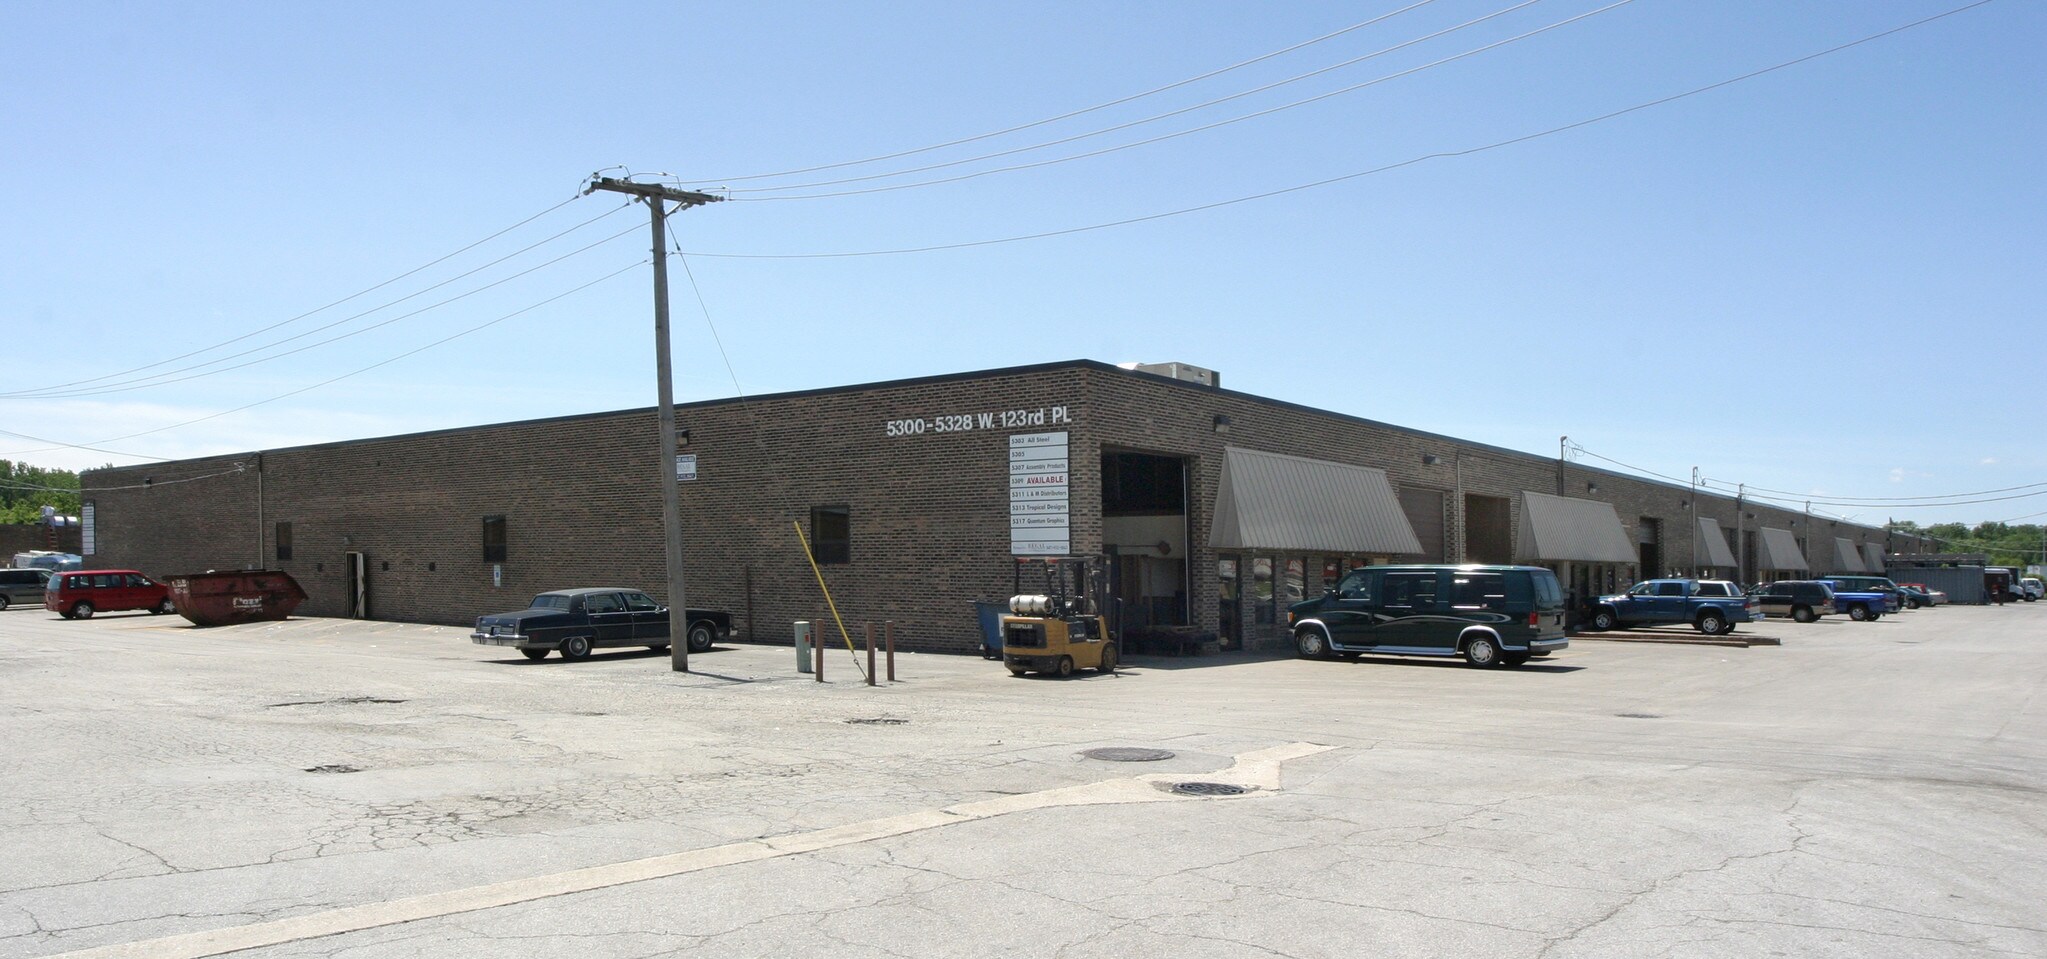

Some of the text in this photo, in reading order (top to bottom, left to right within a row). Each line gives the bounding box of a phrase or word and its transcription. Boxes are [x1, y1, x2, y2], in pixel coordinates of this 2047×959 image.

[887, 405, 1072, 436] 5300-5328 W. 123rd PL
[1027, 476, 1063, 484] AVAILABLE
[1046, 517, 1065, 525] Graphics
